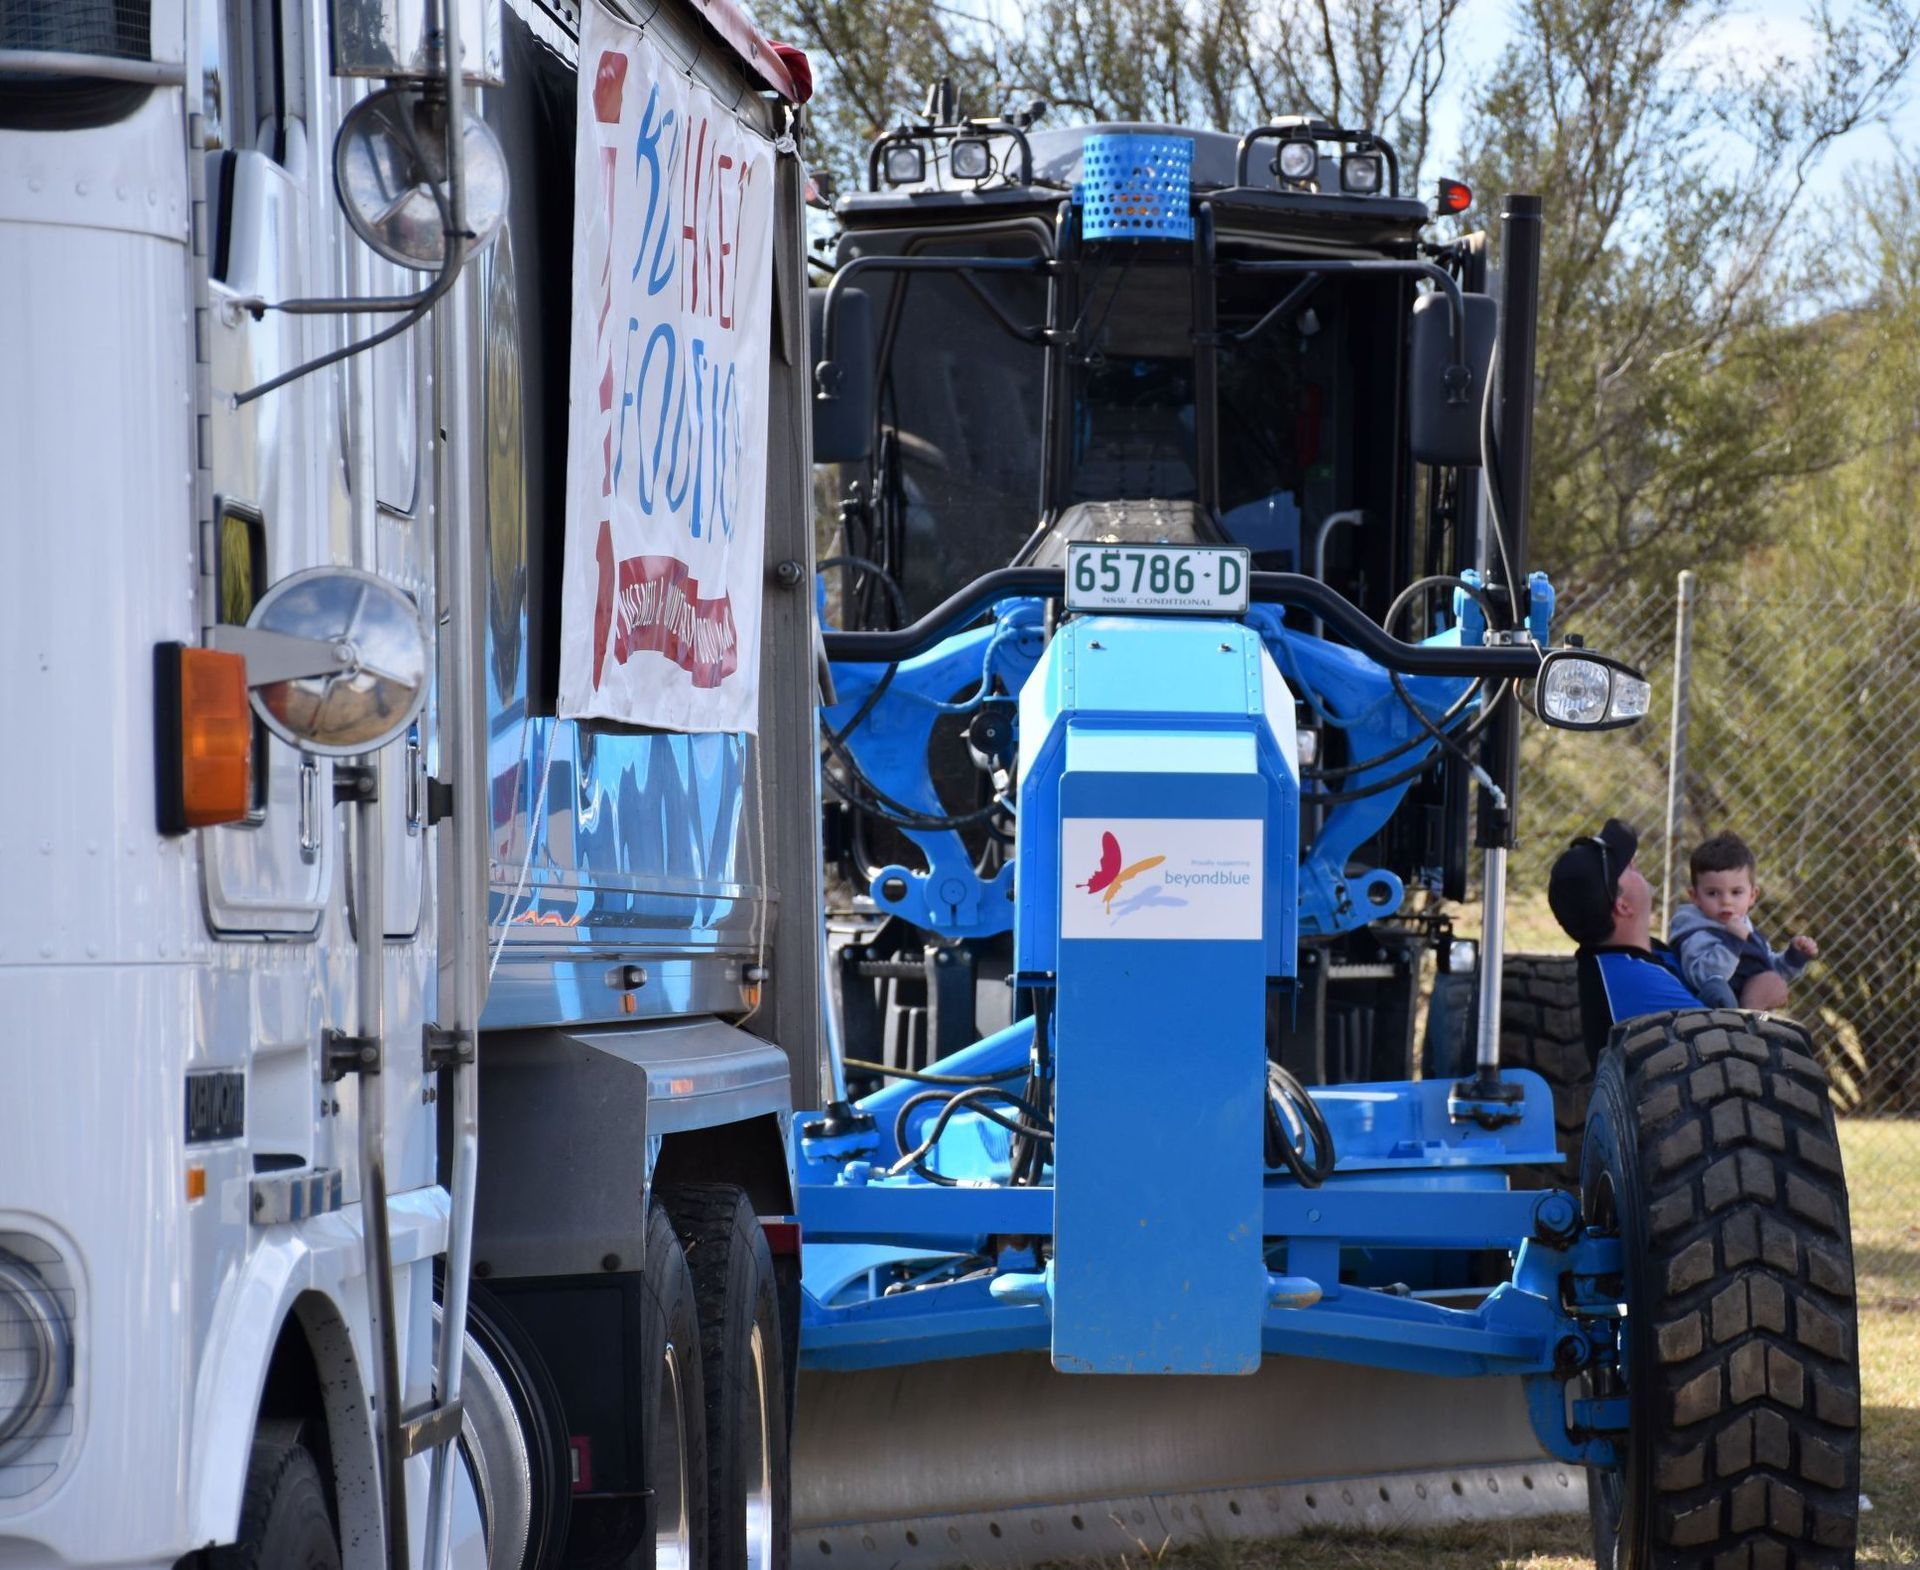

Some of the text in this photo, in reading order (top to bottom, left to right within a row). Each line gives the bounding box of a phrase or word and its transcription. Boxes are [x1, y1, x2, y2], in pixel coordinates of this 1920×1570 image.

[1101, 597, 1127, 605] NSW
[1136, 597, 1213, 607] CONDITIONAL
[1164, 869, 1250, 889] beyondblue
